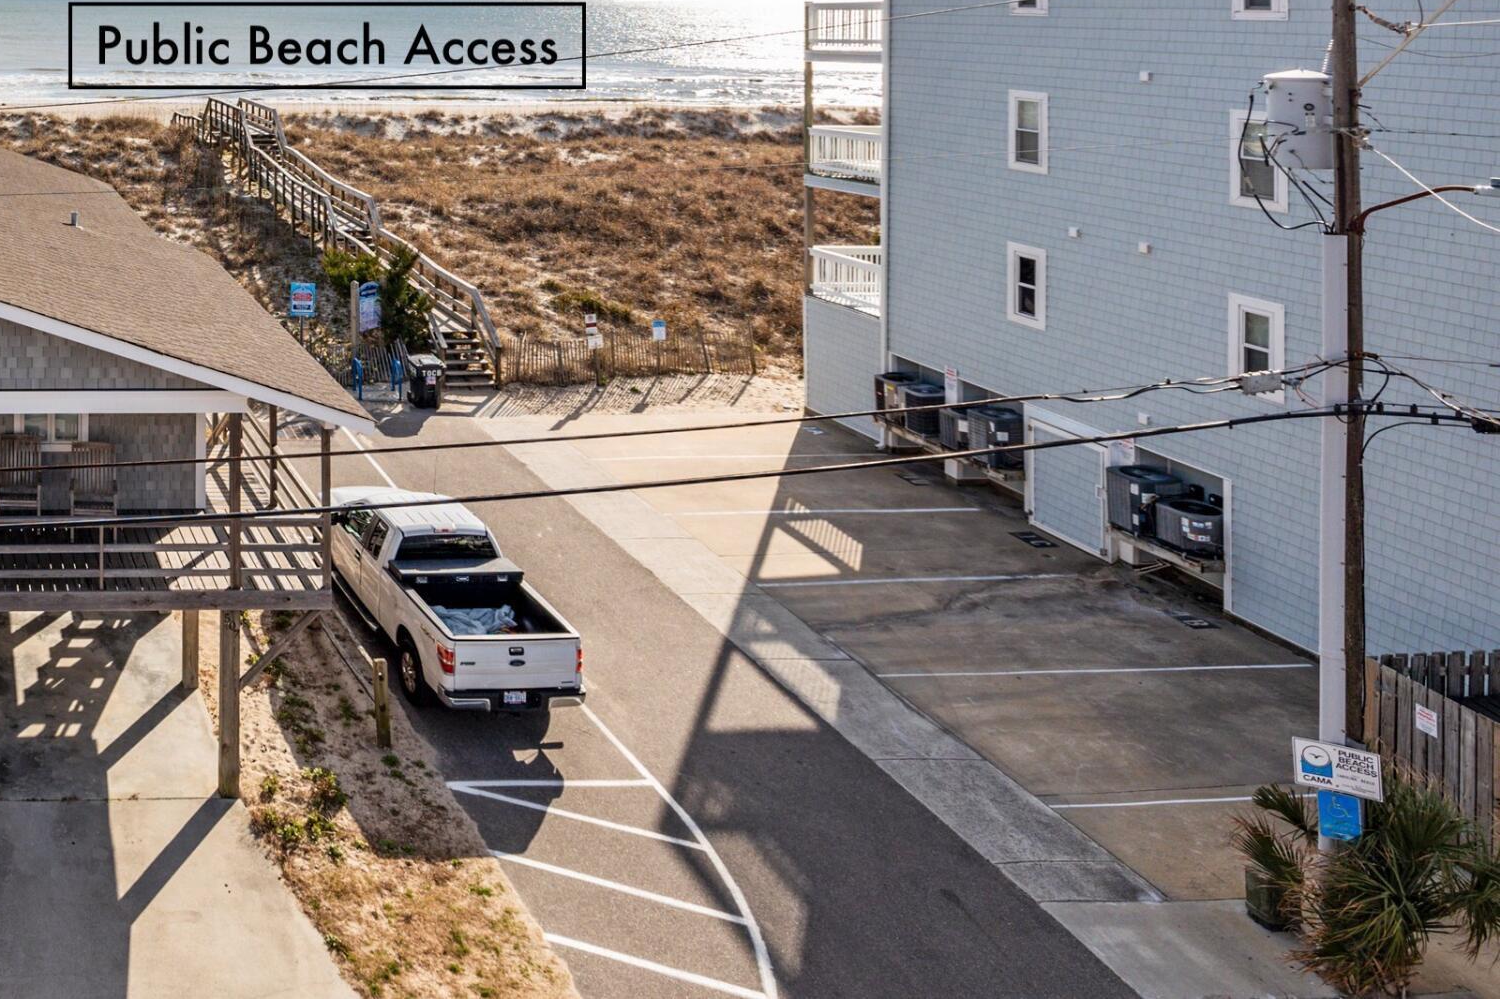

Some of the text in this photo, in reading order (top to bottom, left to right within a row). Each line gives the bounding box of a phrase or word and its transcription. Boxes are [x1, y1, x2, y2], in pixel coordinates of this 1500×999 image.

[1338, 749, 1374, 764] PUBLIC
[1338, 756, 1375, 770] BEACH
[1335, 763, 1378, 778] ACCESS
[1302, 773, 1333, 786] CAMA
